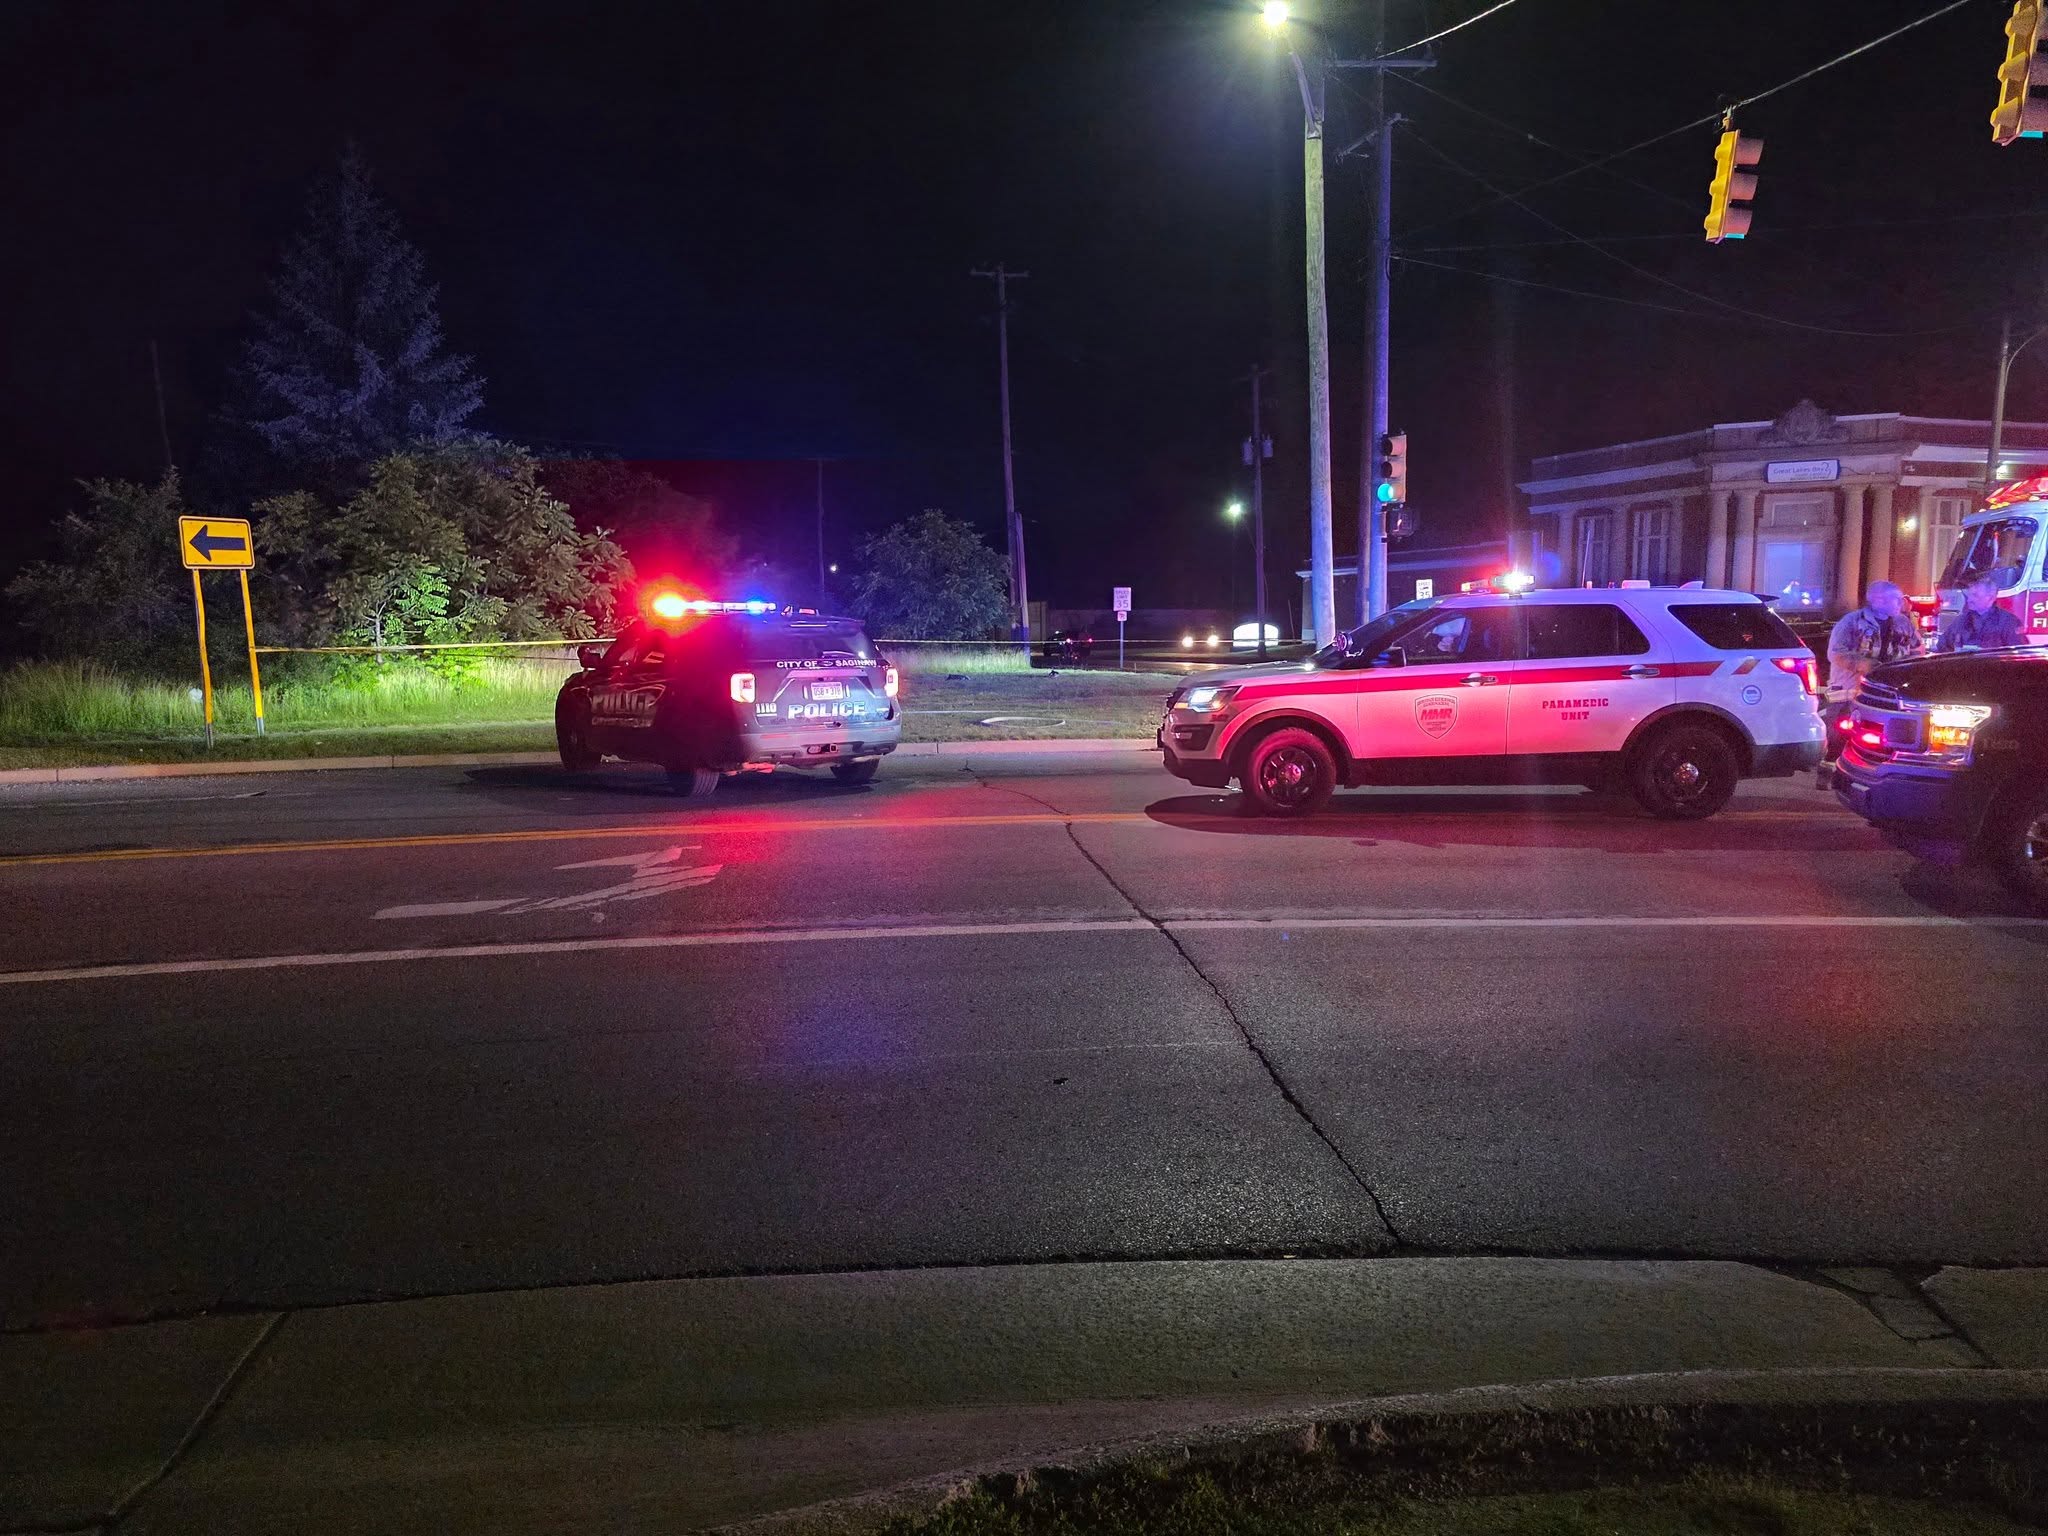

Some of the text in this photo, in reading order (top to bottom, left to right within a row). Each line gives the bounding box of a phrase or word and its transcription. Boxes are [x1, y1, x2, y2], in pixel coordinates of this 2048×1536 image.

[1116, 599, 1129, 609] 35
[776, 659, 877, 669] CITY OF SAGINAW
[756, 702, 777, 714] 1110
[1542, 698, 1609, 709] PARAMEDIC
[788, 702, 866, 719] POLICE
[1561, 711, 1589, 721] UNIT
